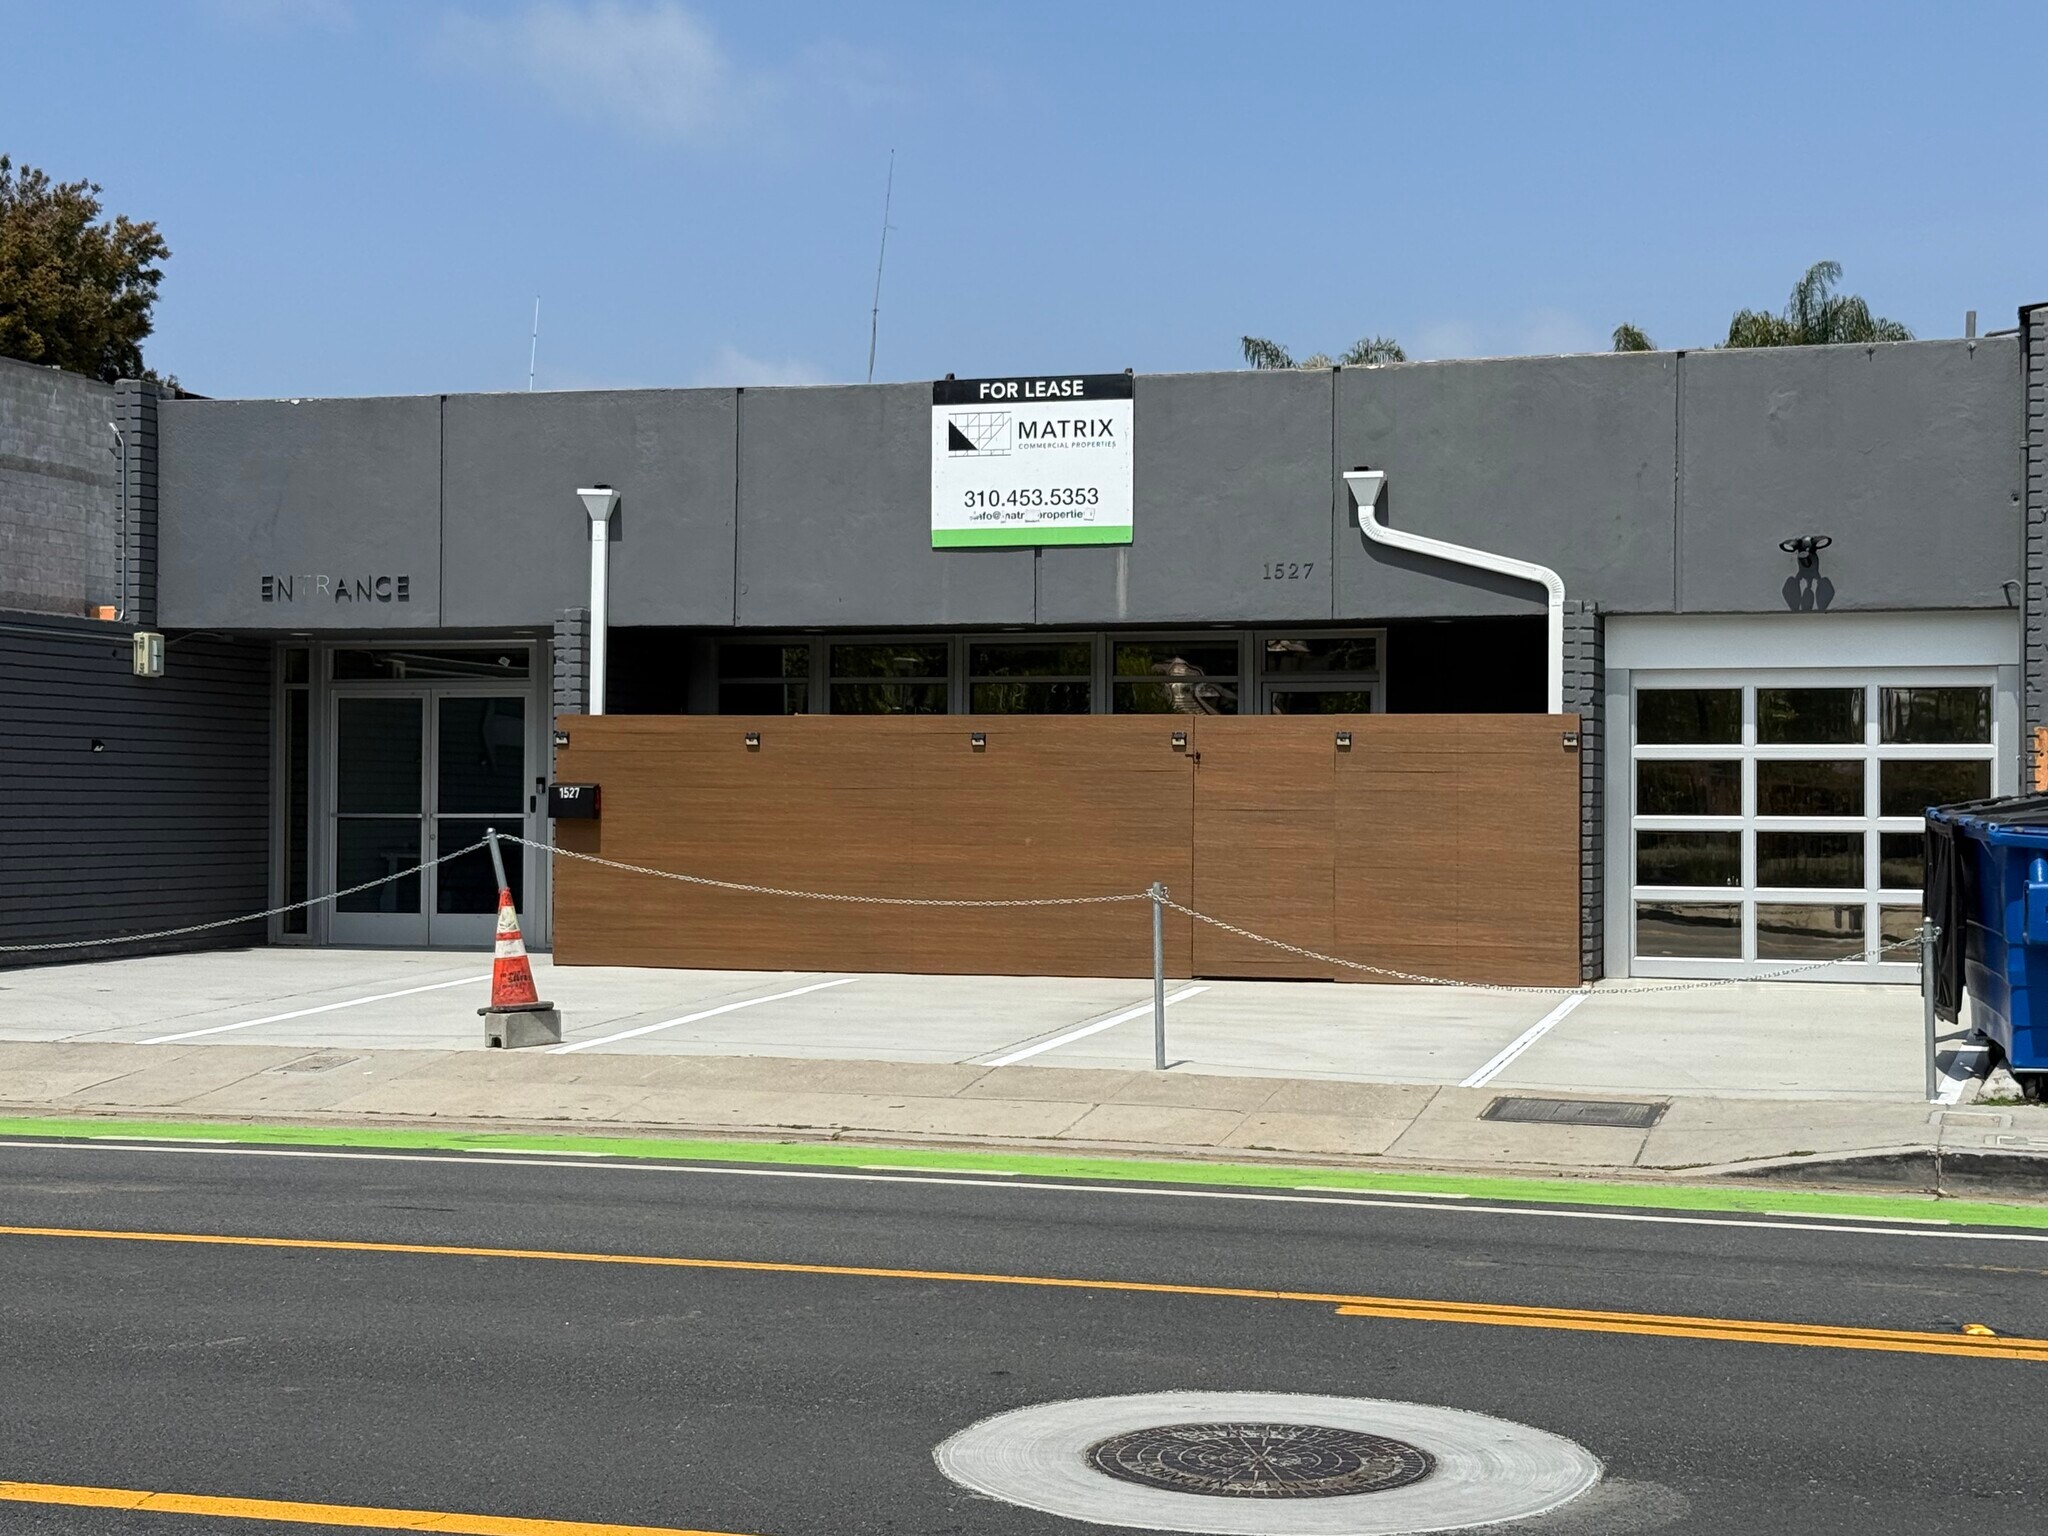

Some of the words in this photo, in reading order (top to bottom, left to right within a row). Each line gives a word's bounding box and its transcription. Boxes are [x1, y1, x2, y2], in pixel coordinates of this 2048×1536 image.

[979, 382, 1019, 399] FOR
[1025, 379, 1084, 398] LEASE
[1018, 418, 1114, 440] MATRIX
[1018, 442, 1069, 450] COMMERCIAL
[1071, 440, 1117, 449] PROPERTIES
[964, 487, 1099, 508] 310.453.5353
[1263, 562, 1314, 580] 1527
[261, 574, 411, 602] ENTRANCE
[559, 787, 580, 799] 1527
